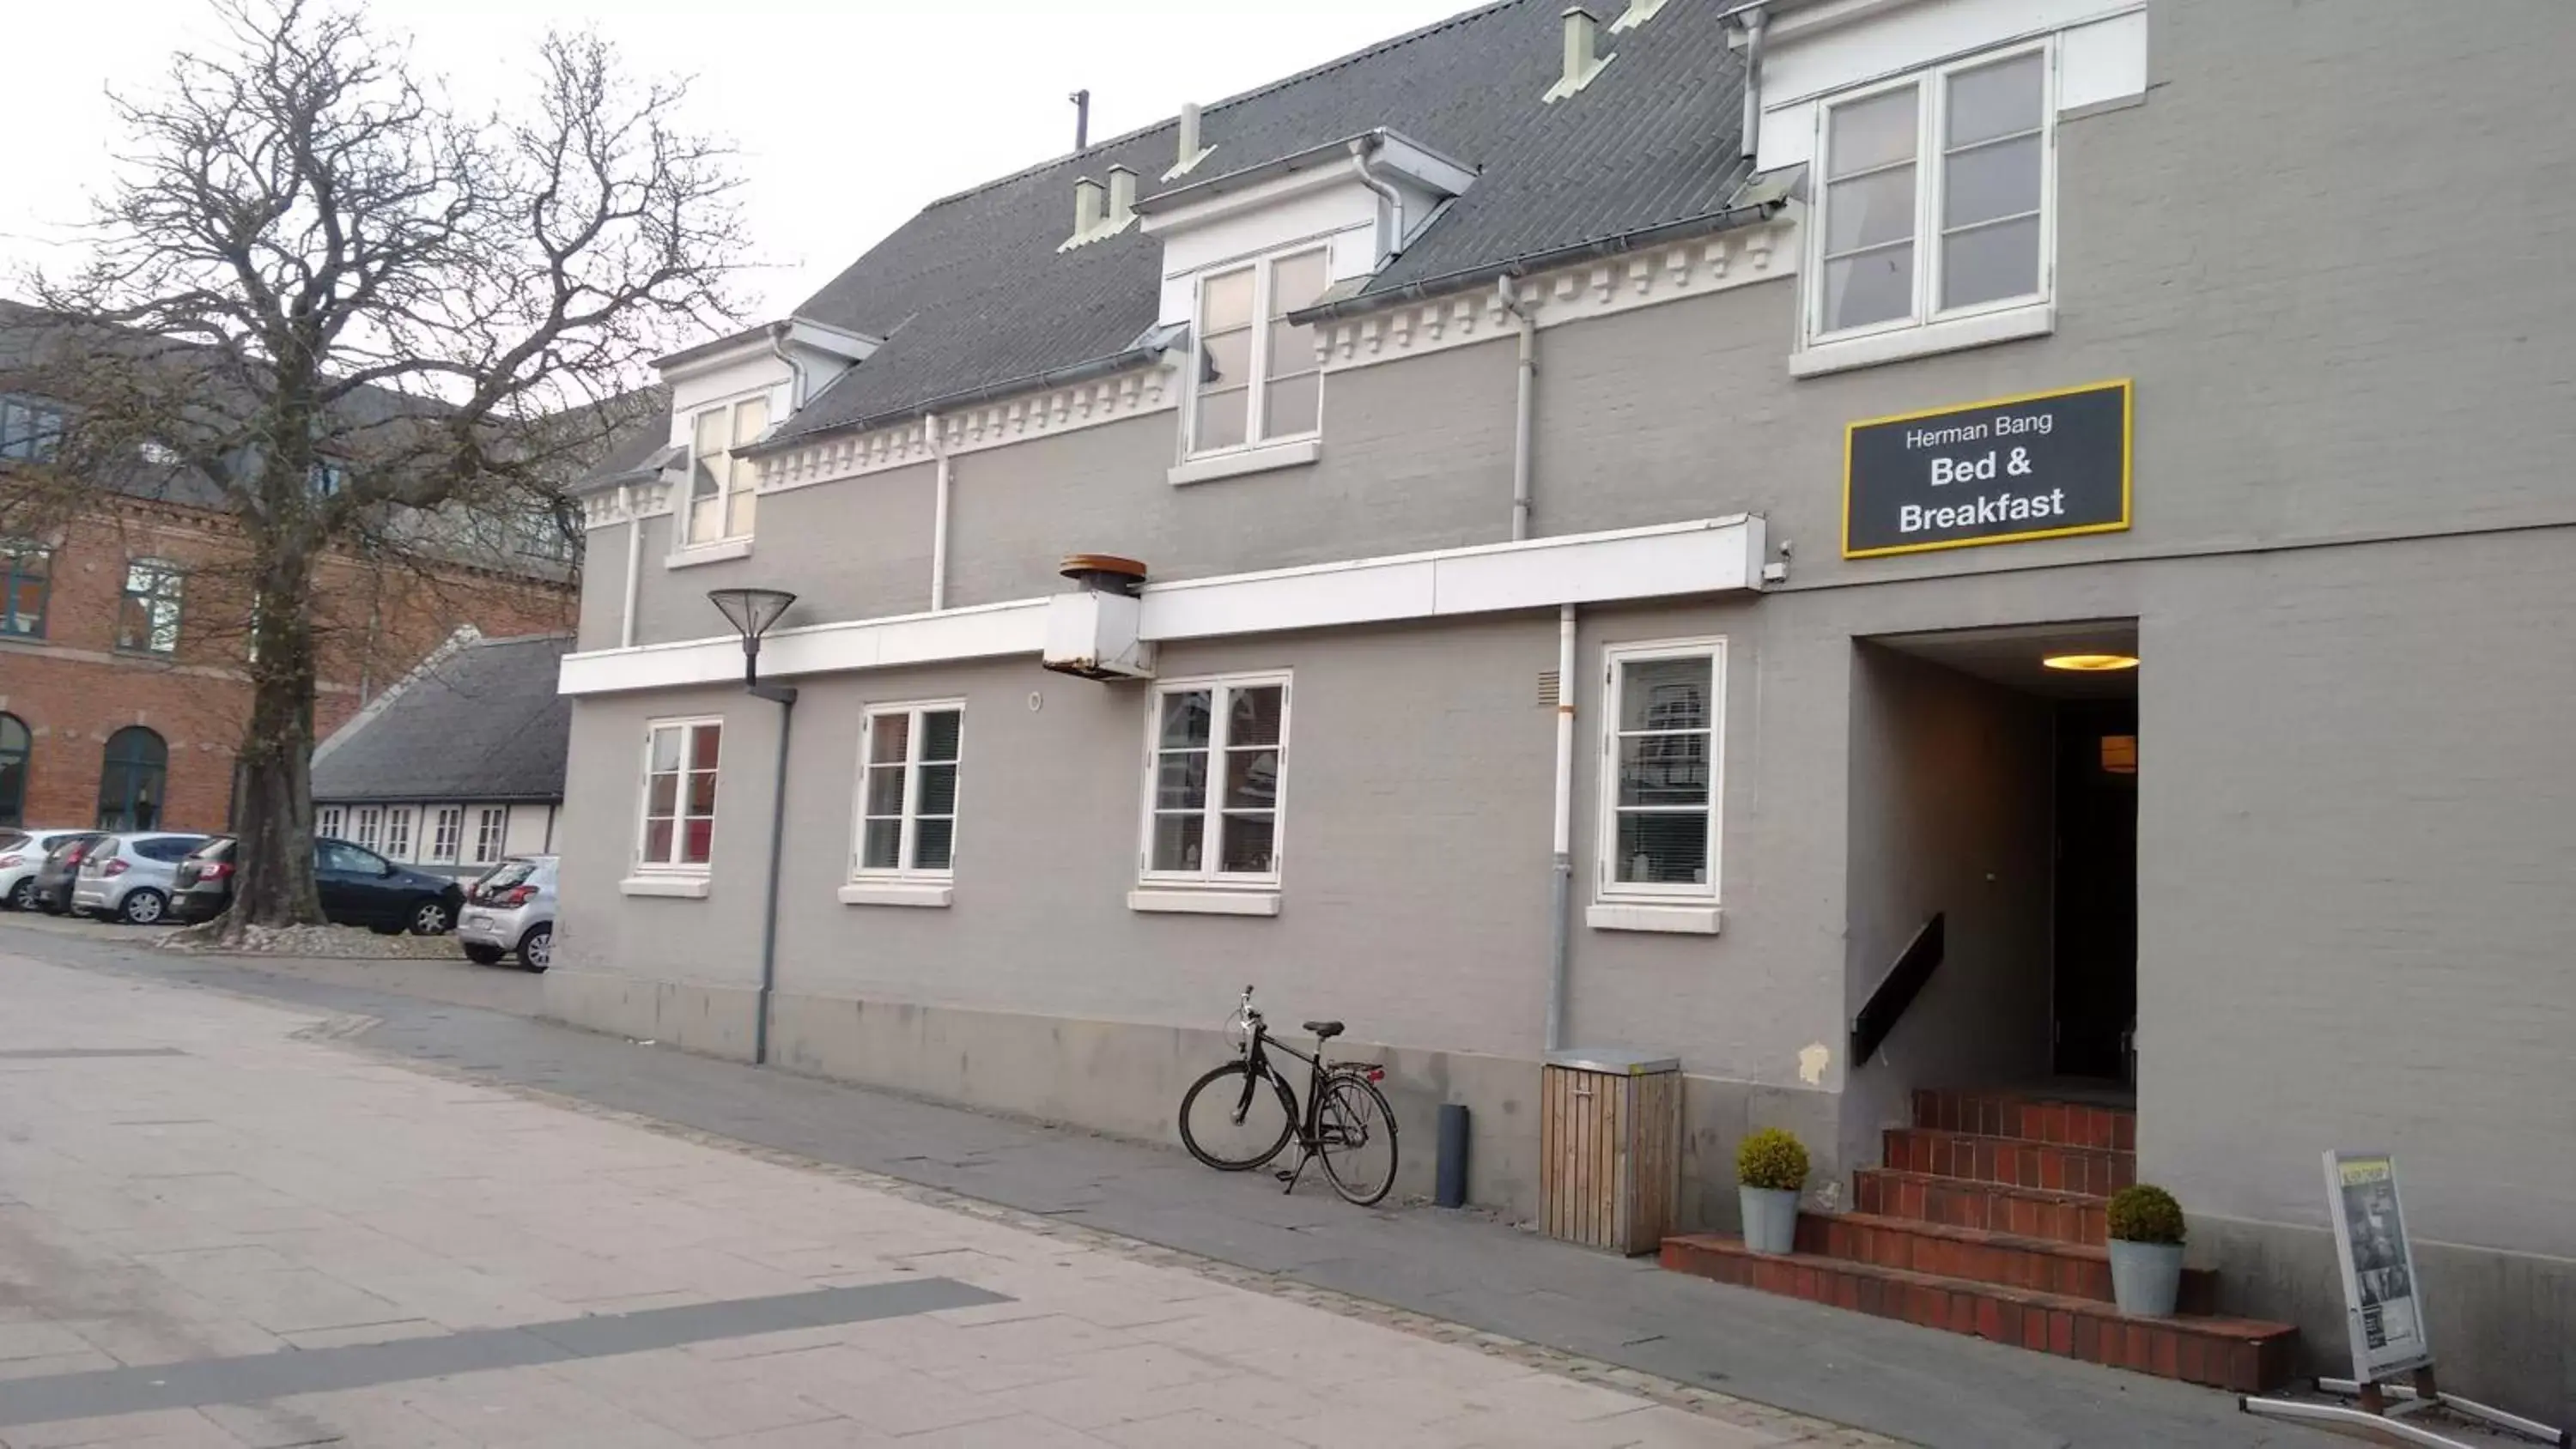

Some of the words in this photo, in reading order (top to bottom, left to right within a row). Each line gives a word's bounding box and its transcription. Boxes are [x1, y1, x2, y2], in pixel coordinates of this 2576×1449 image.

[1905, 422, 1988, 449] Herman
[1995, 414, 2053, 438] Bang
[1931, 451, 1997, 487] Bed
[2007, 446, 2032, 476] &
[1899, 488, 2065, 533] Breakfast
